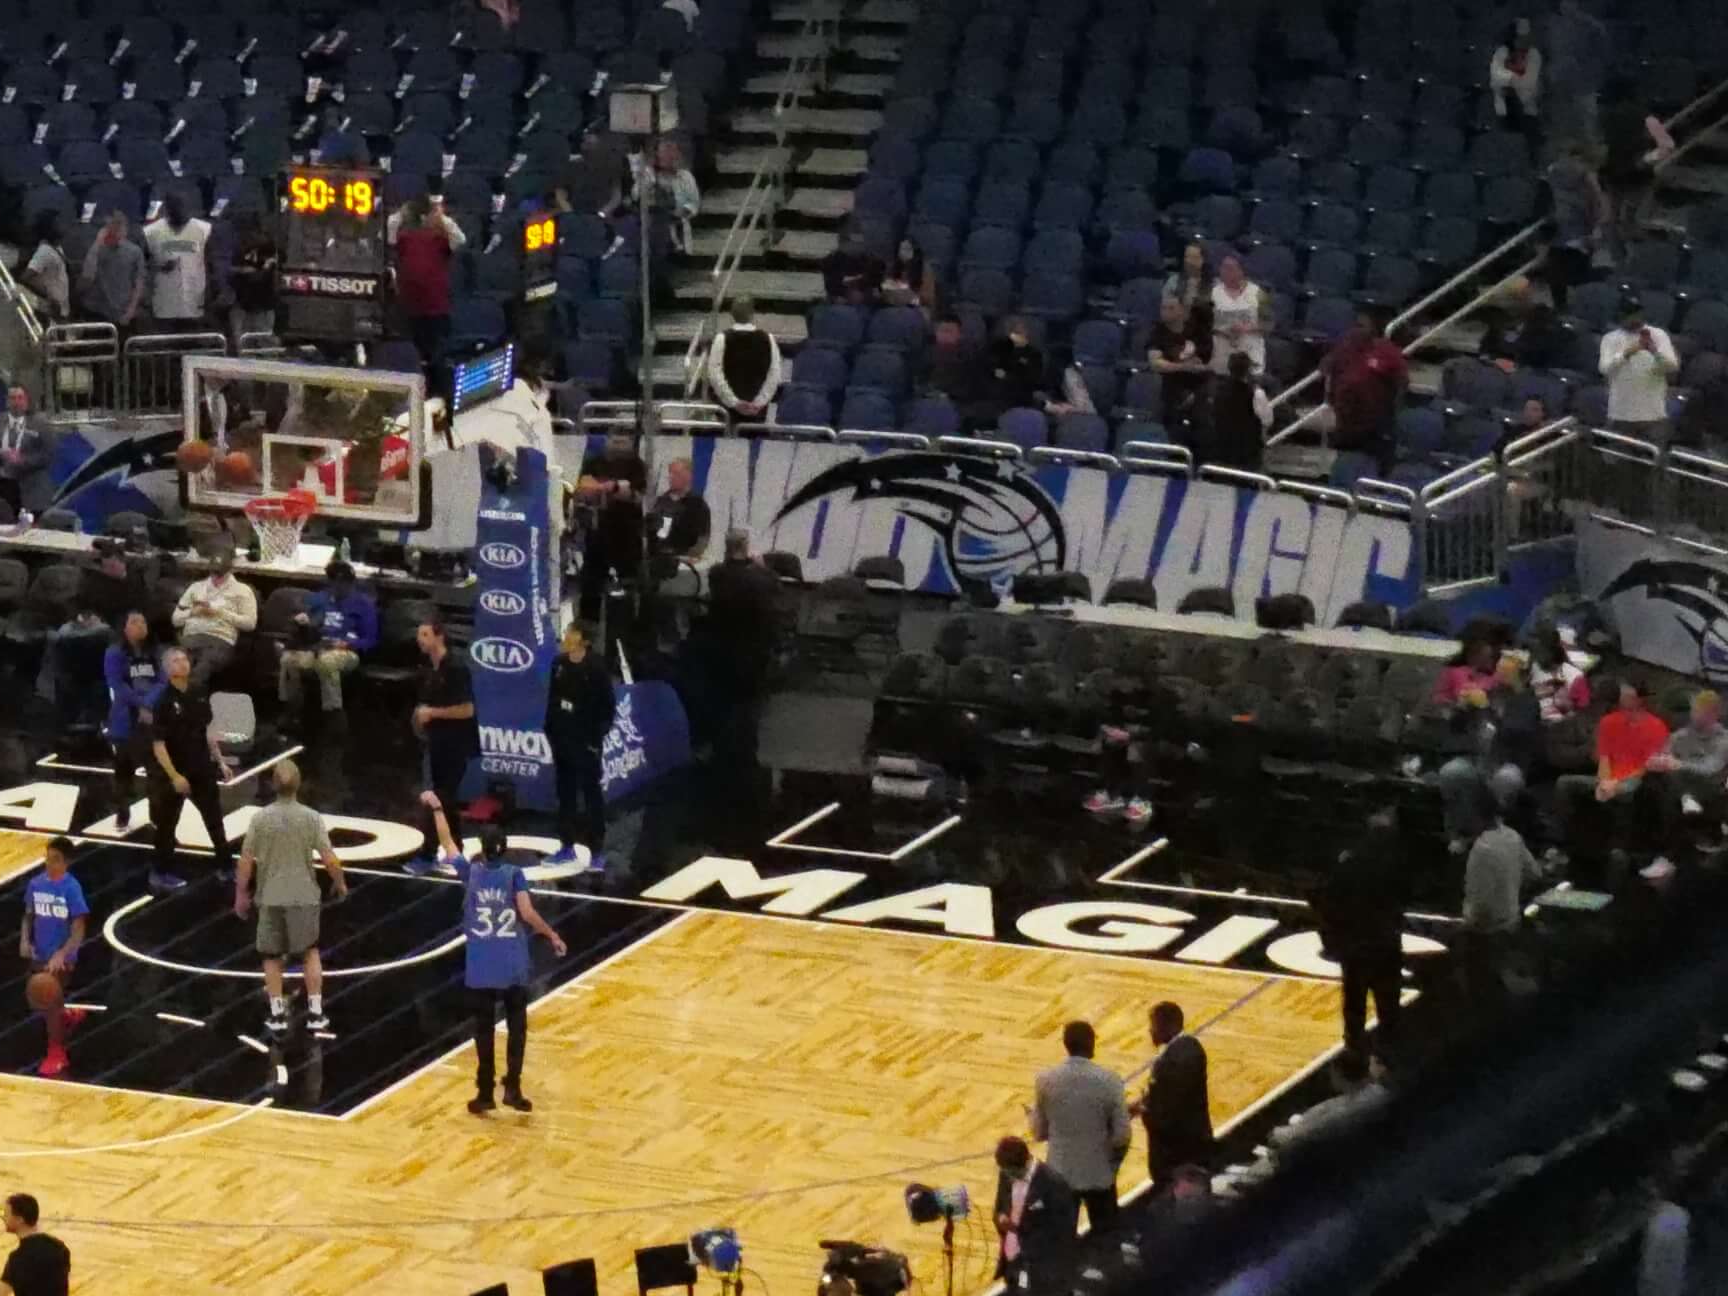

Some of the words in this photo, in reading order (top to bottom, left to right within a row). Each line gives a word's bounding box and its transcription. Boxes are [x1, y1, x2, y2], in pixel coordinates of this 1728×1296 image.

[290, 177, 373, 215] 50:19
[310, 276, 378, 295] TISSOT
[1058, 465, 1420, 626] MAGIC
[479, 725, 553, 765] mway
[480, 757, 540, 777] CENTER
[470, 908, 518, 939] 32
